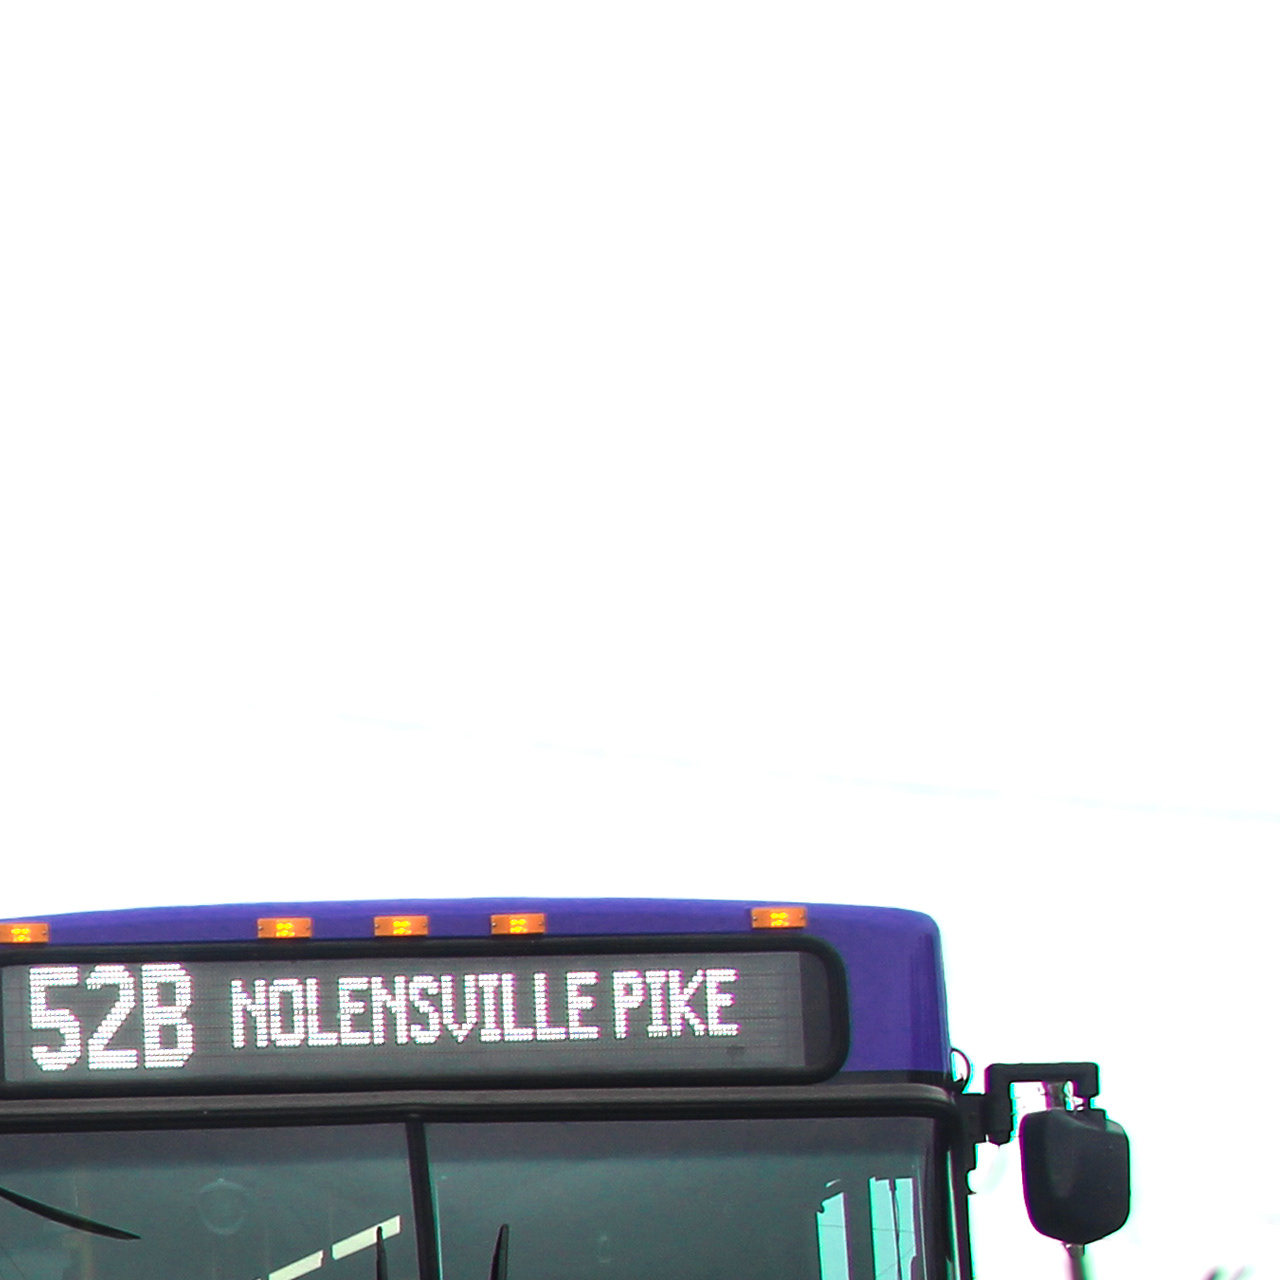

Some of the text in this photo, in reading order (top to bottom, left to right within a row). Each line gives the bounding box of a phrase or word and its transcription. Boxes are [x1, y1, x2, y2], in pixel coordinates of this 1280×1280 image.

[28, 962, 741, 1071] 52B NOLENSVILLE PIKE
